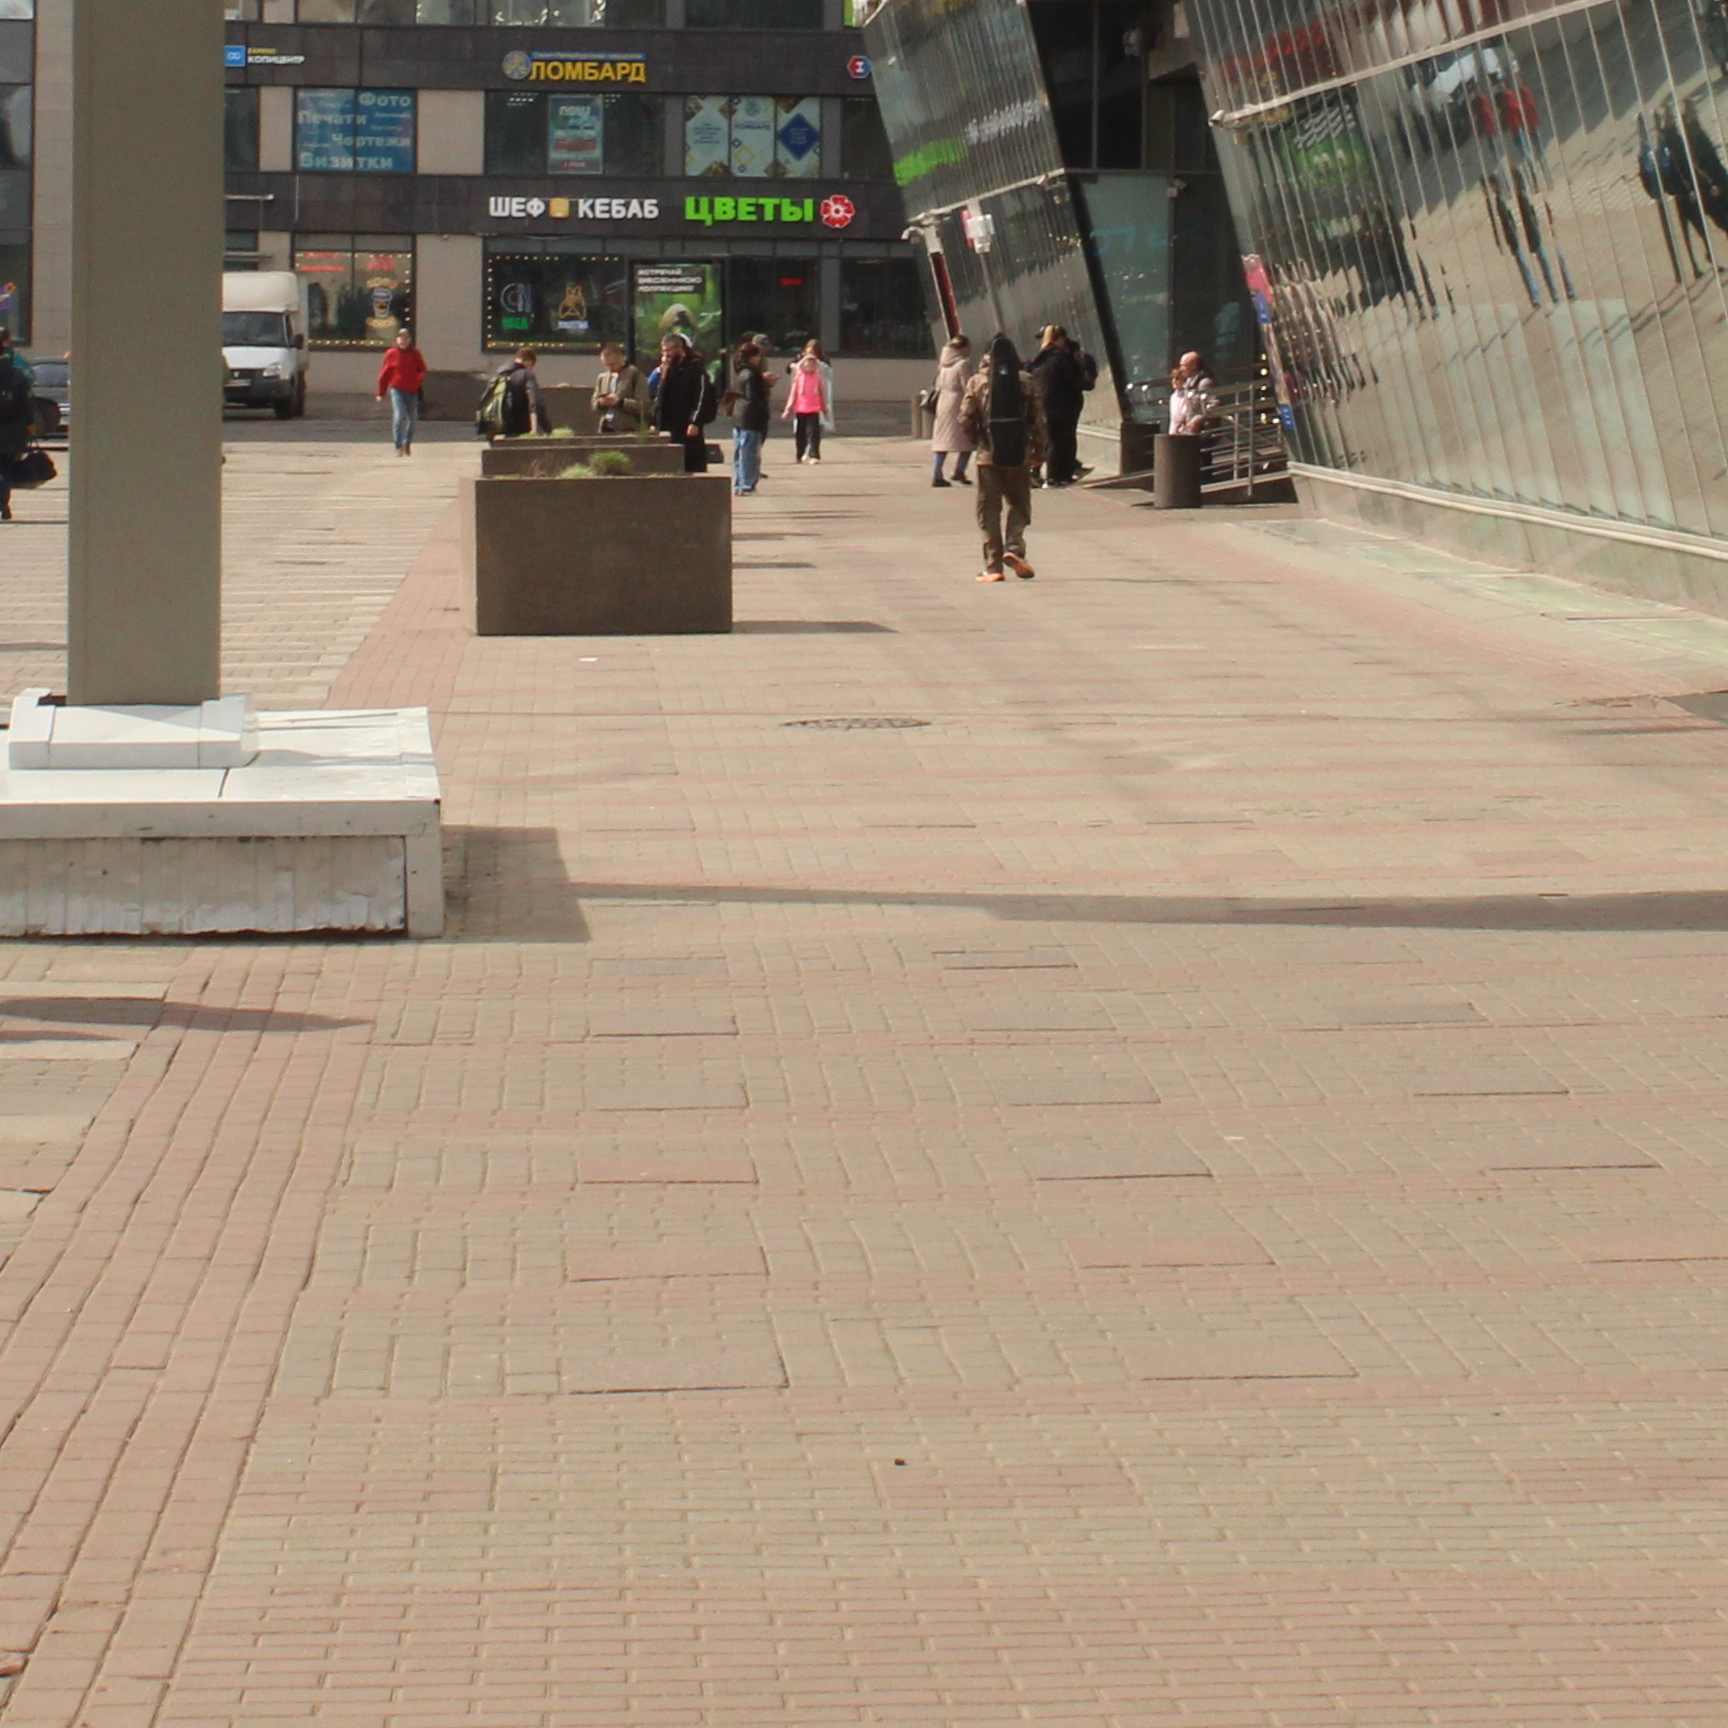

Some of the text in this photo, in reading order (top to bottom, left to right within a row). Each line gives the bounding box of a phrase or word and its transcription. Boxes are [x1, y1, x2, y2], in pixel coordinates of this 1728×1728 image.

[529, 62, 646, 83] ЛОМБАРД
[359, 92, 411, 107] Фото
[489, 197, 659, 219] ШЕФ КЕБАБ
[684, 196, 813, 226] ЦВЕТЫ
